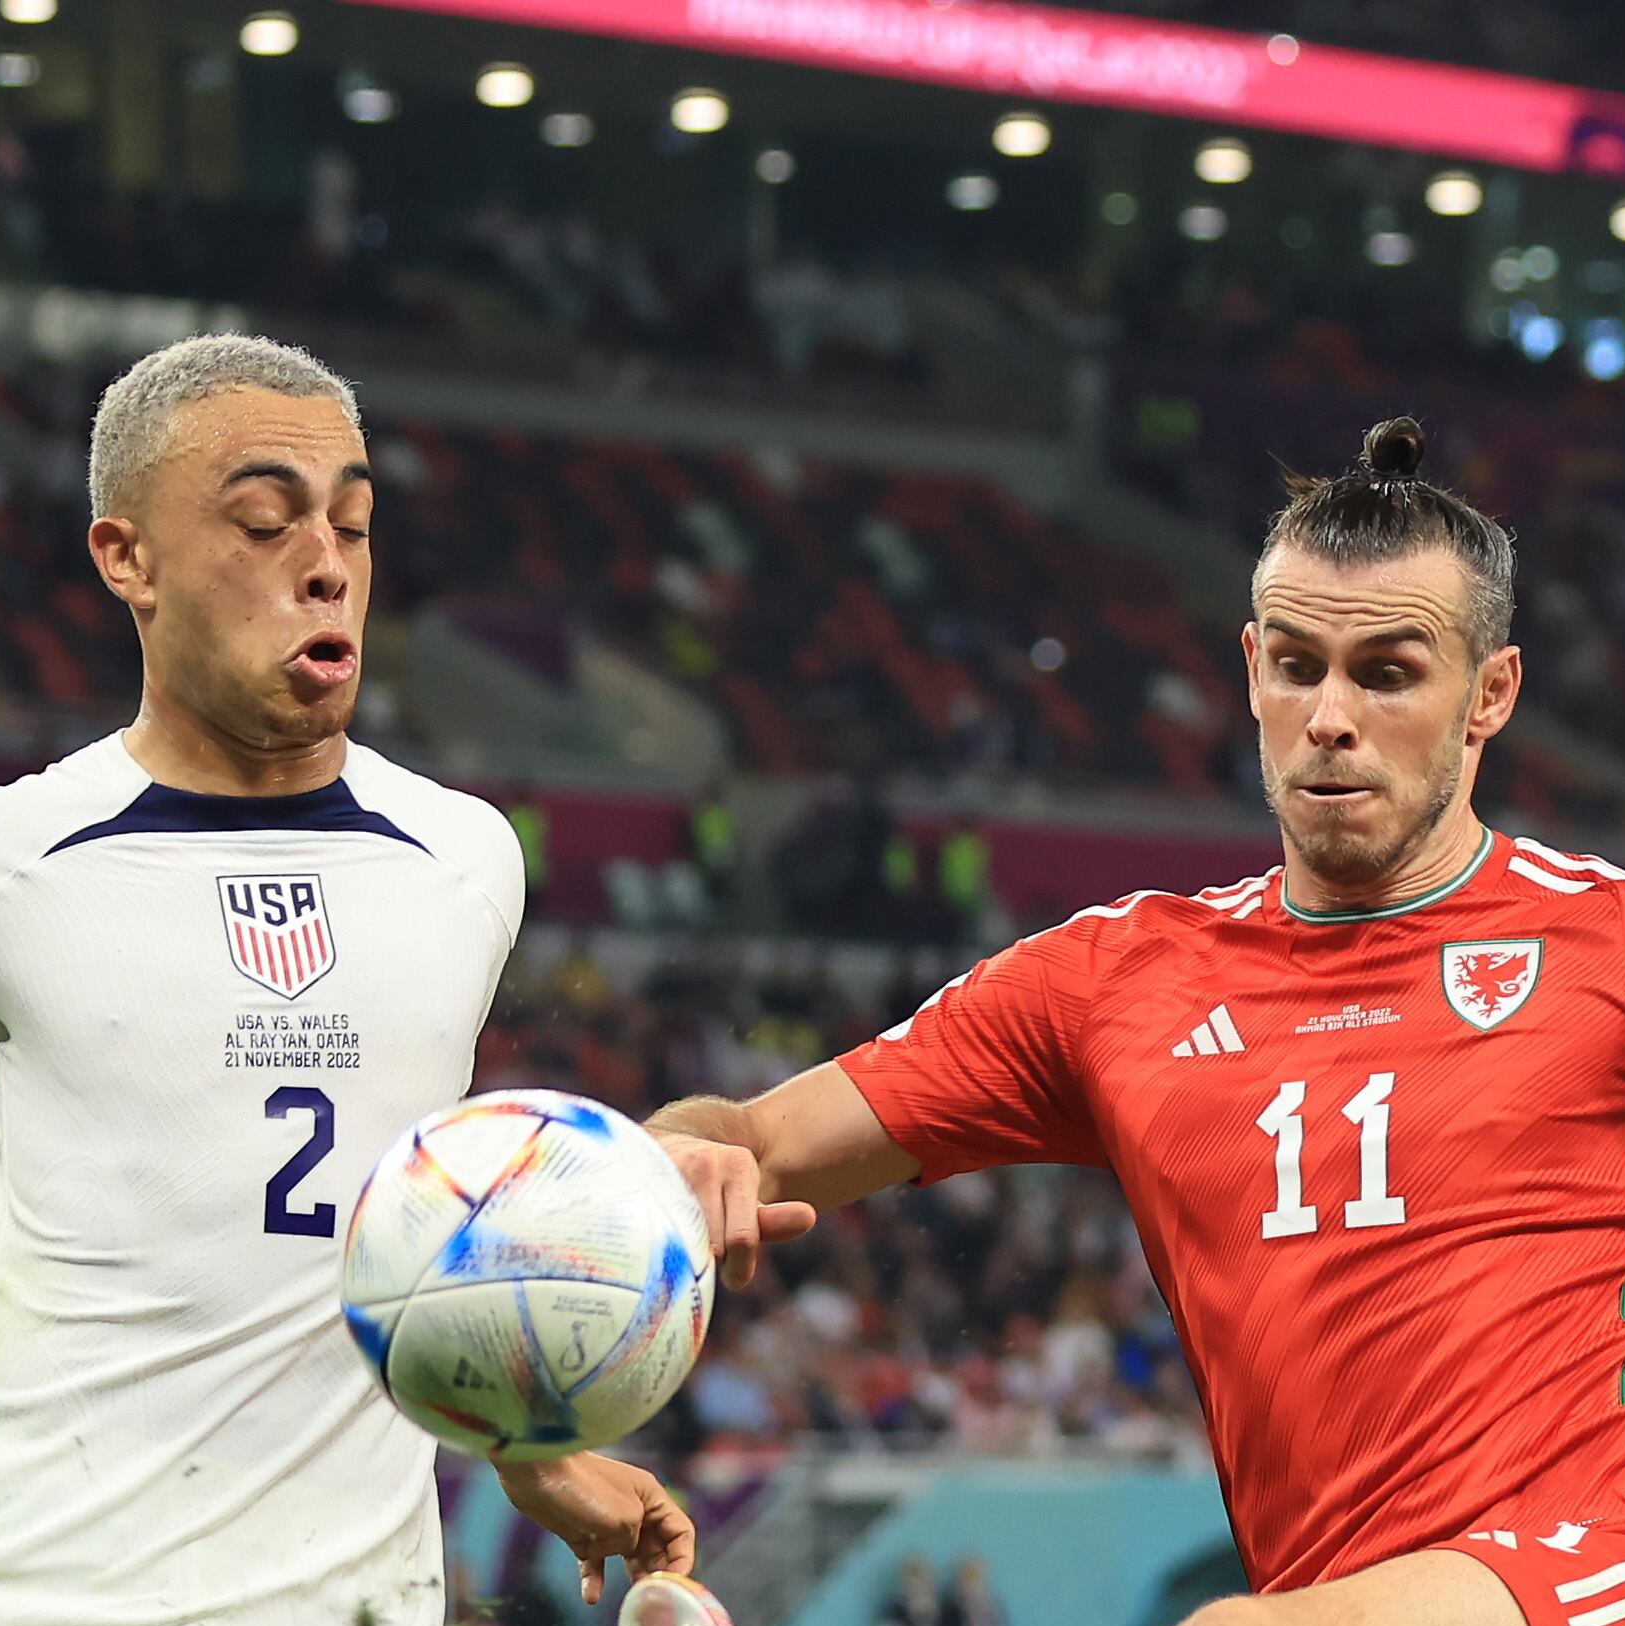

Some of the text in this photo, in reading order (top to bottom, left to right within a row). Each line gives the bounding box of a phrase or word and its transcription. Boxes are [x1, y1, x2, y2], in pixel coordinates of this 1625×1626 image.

[227, 883, 316, 927] USA
[1343, 1004, 1360, 1014] USA
[236, 1014, 349, 1030] USA VS. WALES
[1320, 1012, 1367, 1023] NOVEMBER
[1345, 1020, 1361, 1028] ALI
[1362, 1014, 1401, 1027] STADIUM
[225, 1033, 359, 1049] AL RAYYAN, QATAR
[225, 1052, 360, 1068] 21 NOVEMBER 2022
[264, 1086, 336, 1238] 2
[1255, 1072, 1407, 1239] 11
